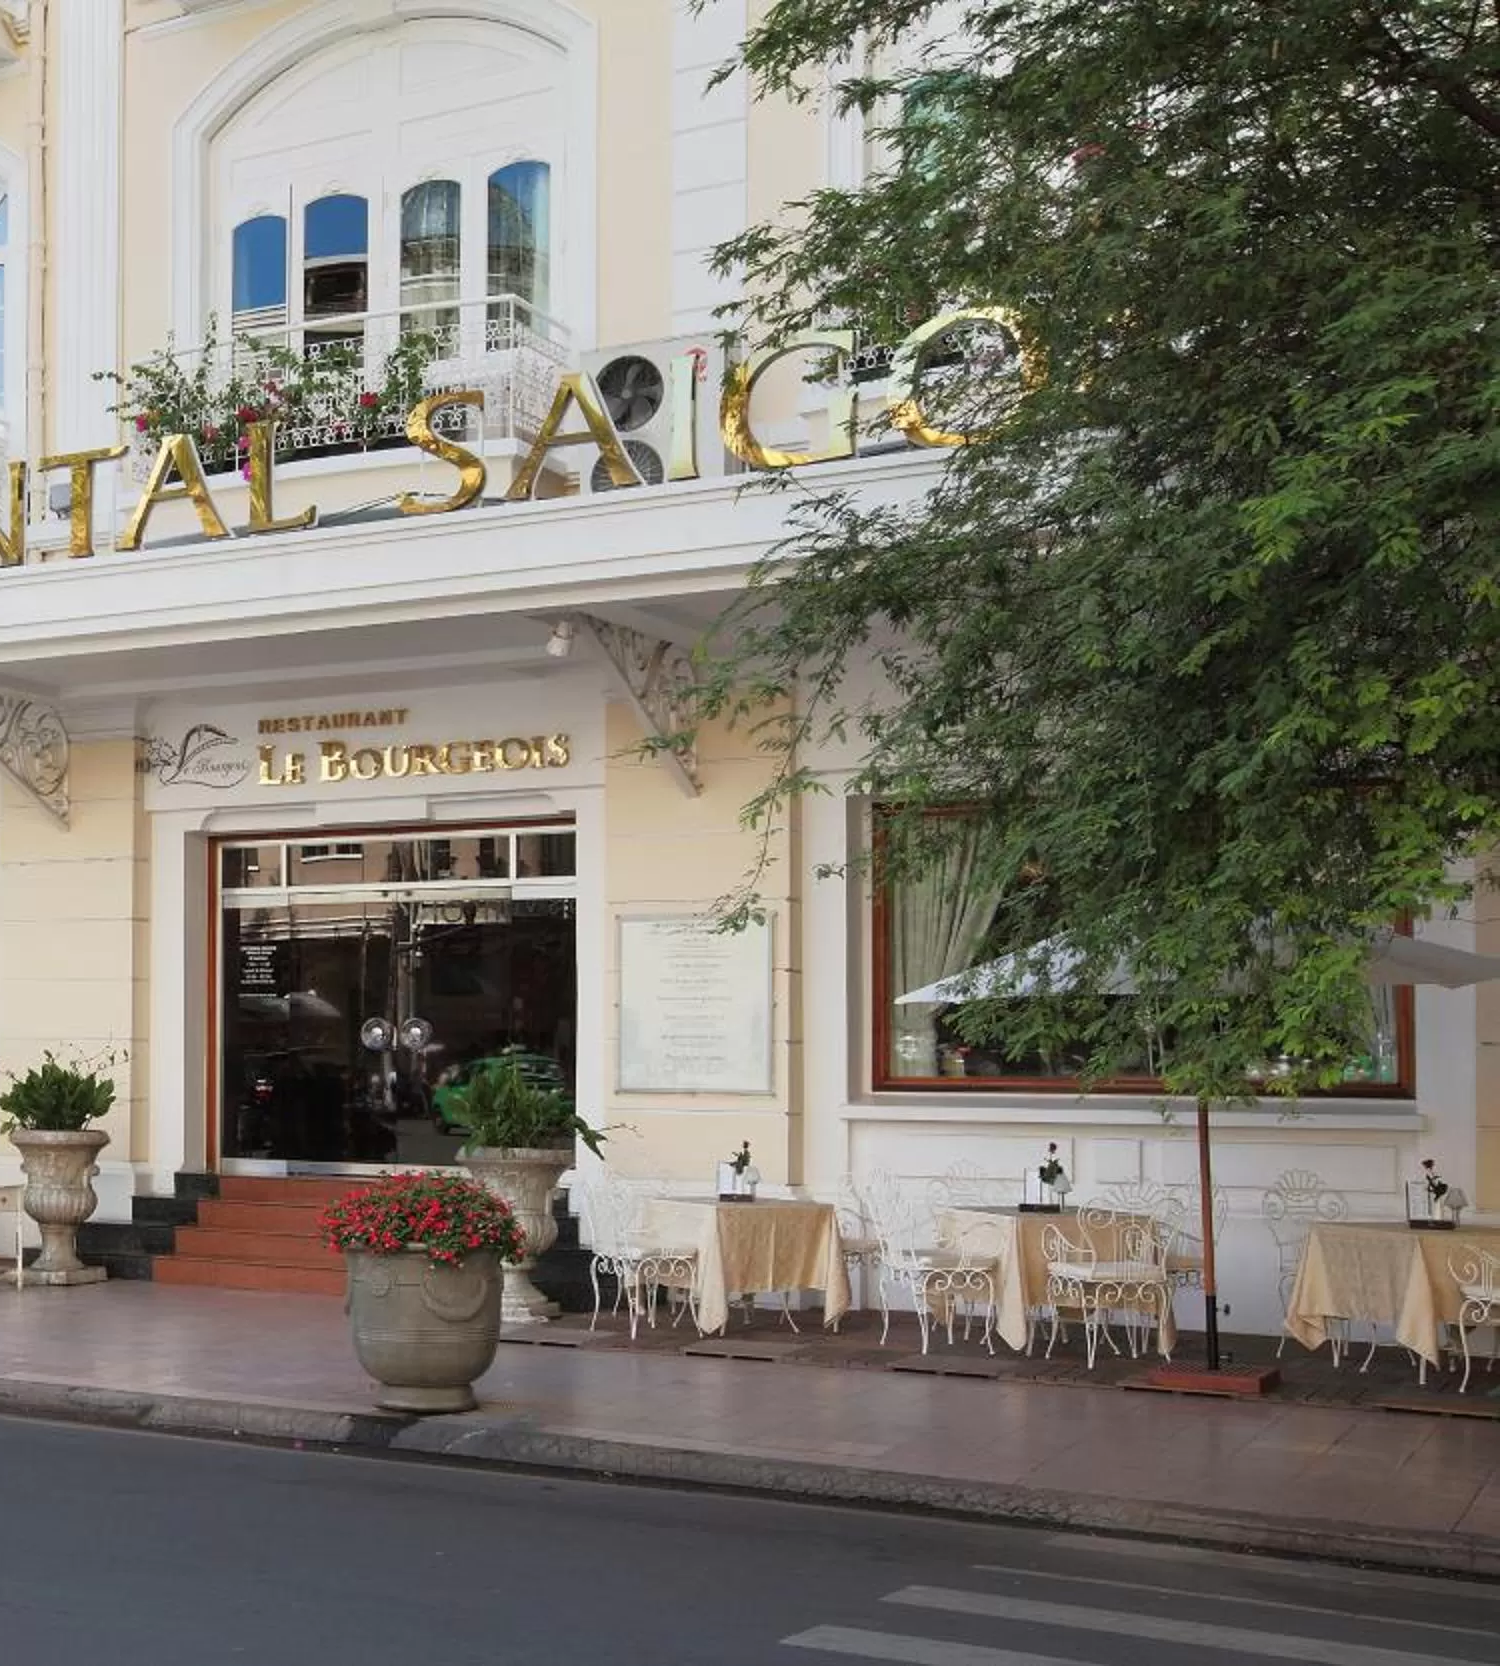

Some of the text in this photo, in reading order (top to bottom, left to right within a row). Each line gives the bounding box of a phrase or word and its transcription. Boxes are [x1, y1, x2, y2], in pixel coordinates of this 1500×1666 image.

[397, 304, 1150, 515] SAIGO
[257, 707, 410, 735] RESTAURANT
[316, 732, 572, 784] BOURGEOIS
